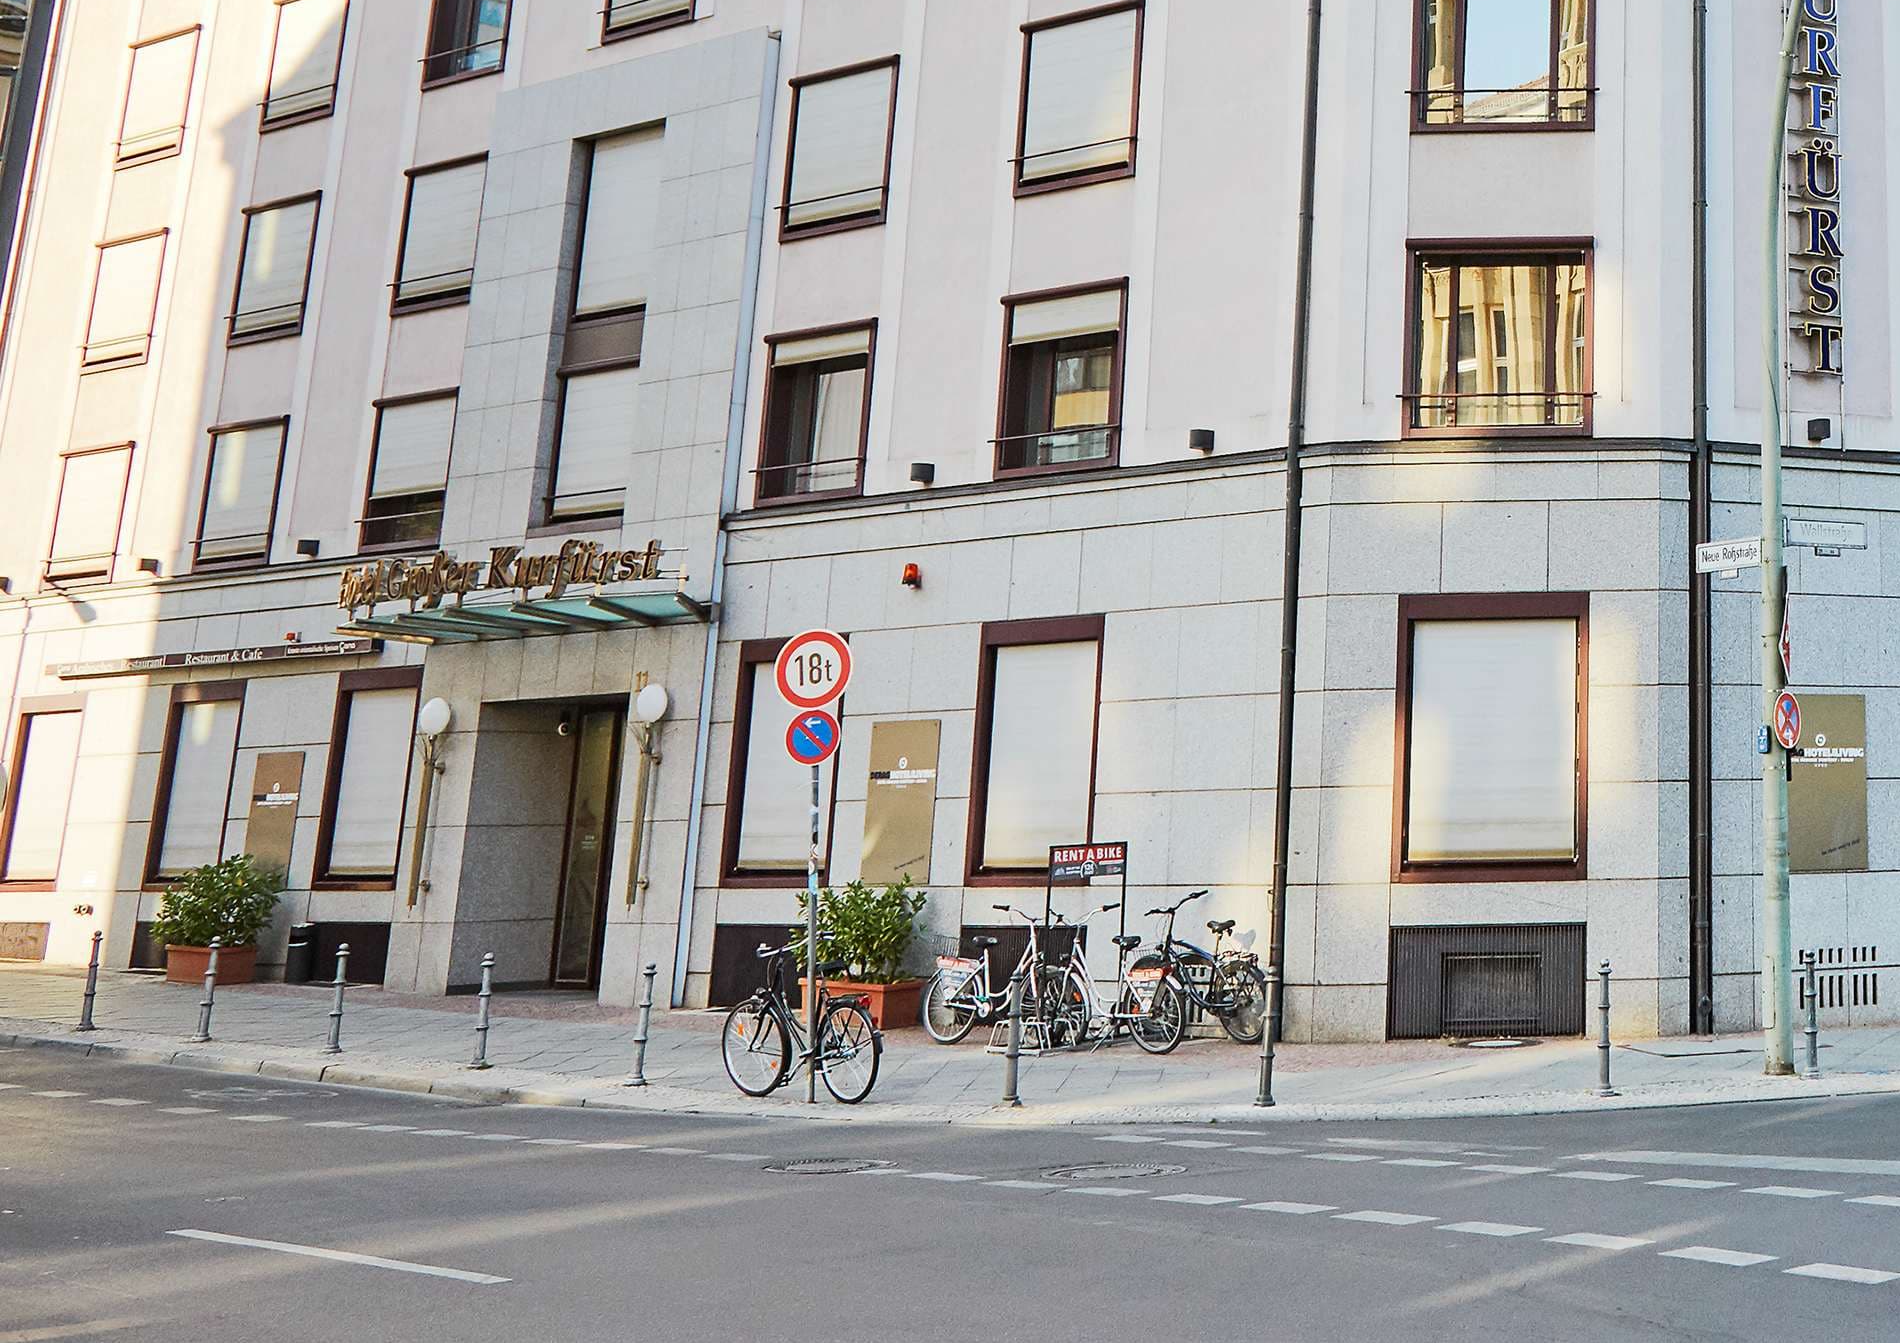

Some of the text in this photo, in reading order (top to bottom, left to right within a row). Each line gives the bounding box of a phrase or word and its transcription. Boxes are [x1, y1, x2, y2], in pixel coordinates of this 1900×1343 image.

[1701, 546, 1759, 564] Neue Roßstraße
[338, 539, 660, 609] Hotel Großer Kurfürst
[184, 653, 230, 665] Restaurant
[230, 650, 240, 662] &
[1054, 846, 1121, 862] RENT A BIKE
